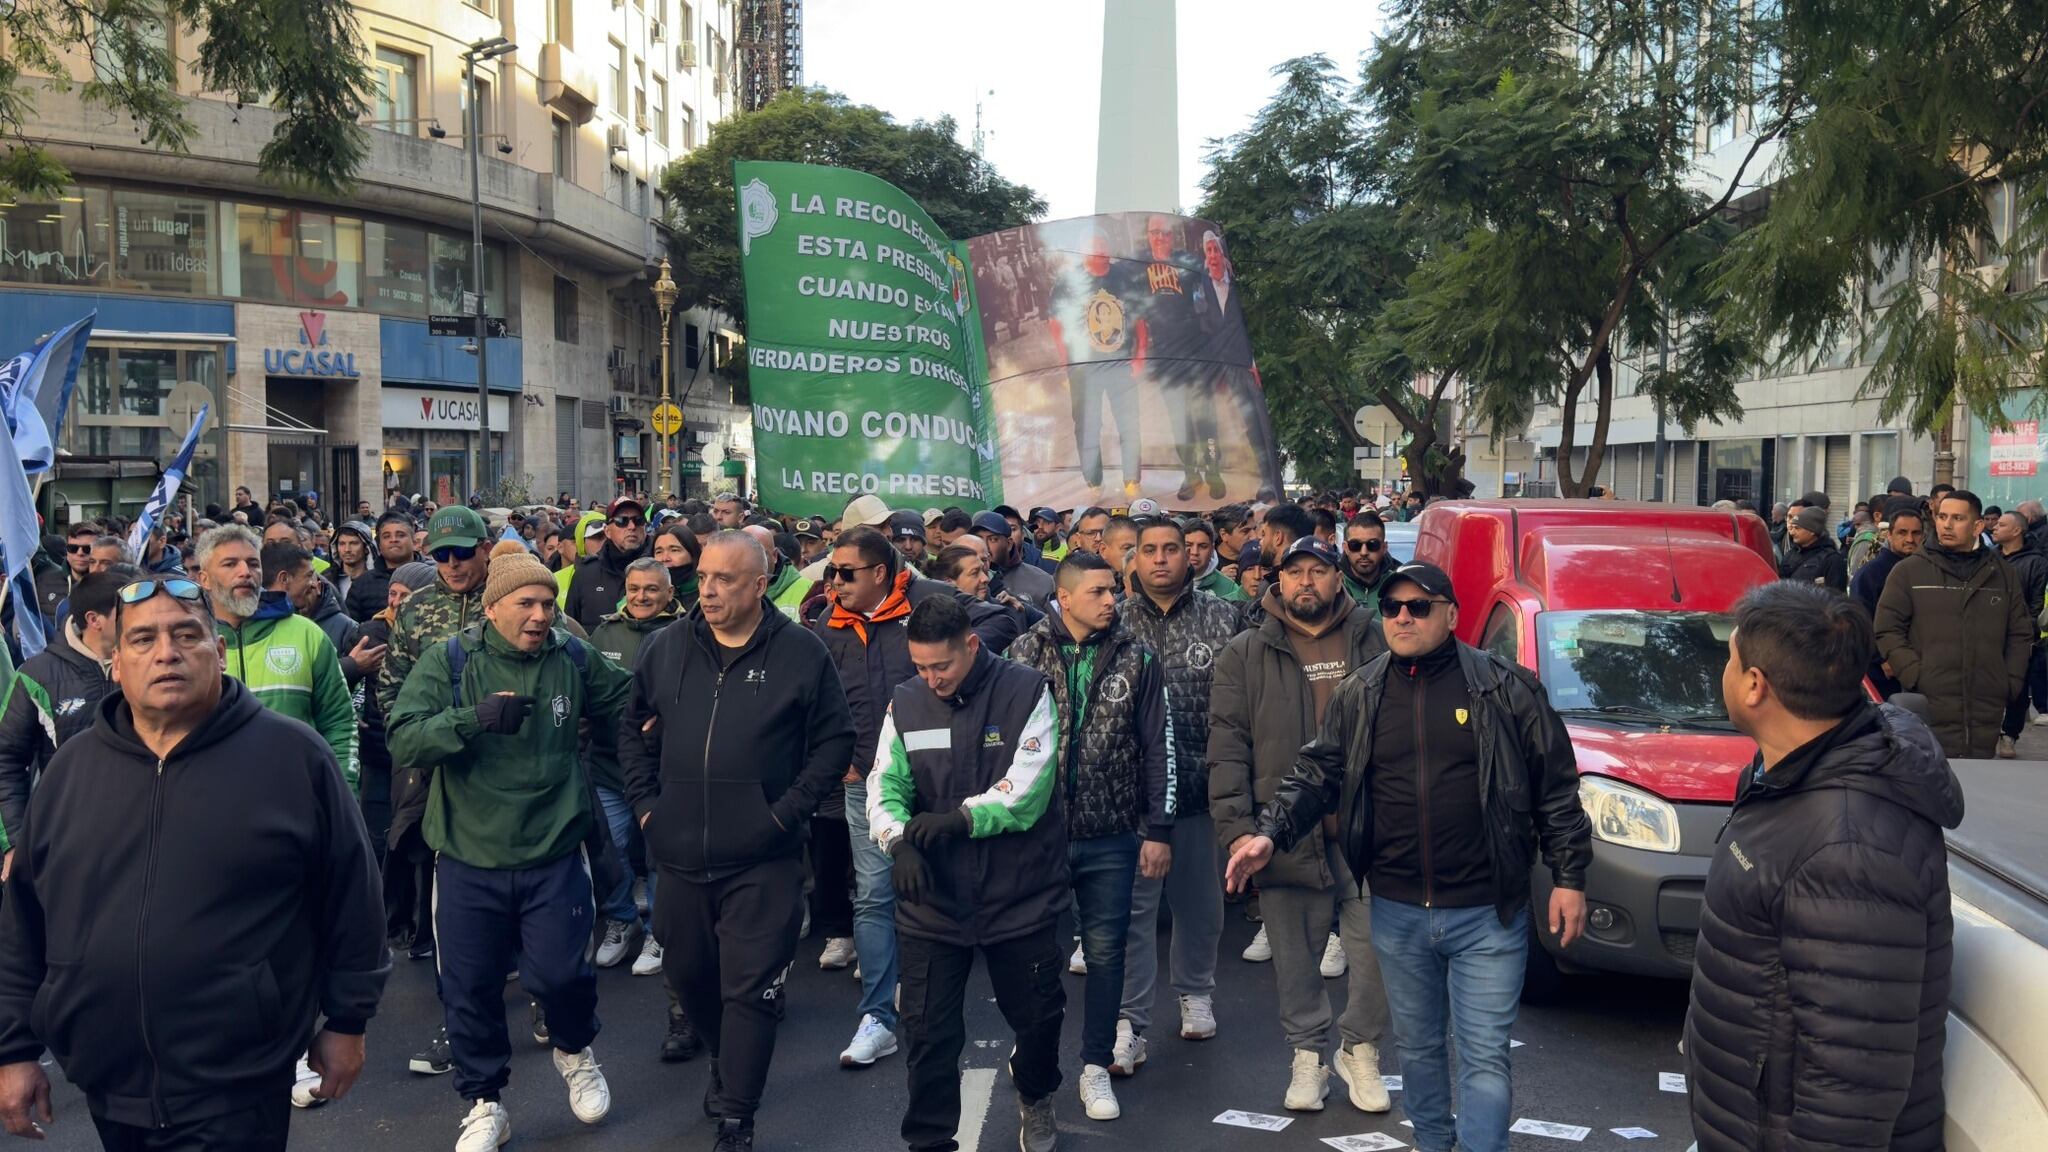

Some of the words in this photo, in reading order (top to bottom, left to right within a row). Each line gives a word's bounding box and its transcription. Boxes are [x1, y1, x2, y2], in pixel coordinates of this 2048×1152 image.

[791, 193, 825, 215] LA
[134, 219, 149, 232] un
[152, 216, 189, 236] lugar
[798, 235, 868, 261] ESTA
[171, 251, 208, 273] ideas
[798, 276, 909, 309] CUANDO
[829, 318, 951, 351] NUESTROS
[264, 348, 361, 377] UCASAL
[749, 346, 901, 374] VERDADEROS
[438, 400, 481, 421] UCASA
[782, 467, 805, 491] LA
[812, 471, 879, 494] RECO
[1730, 841, 1754, 871] Babolat
